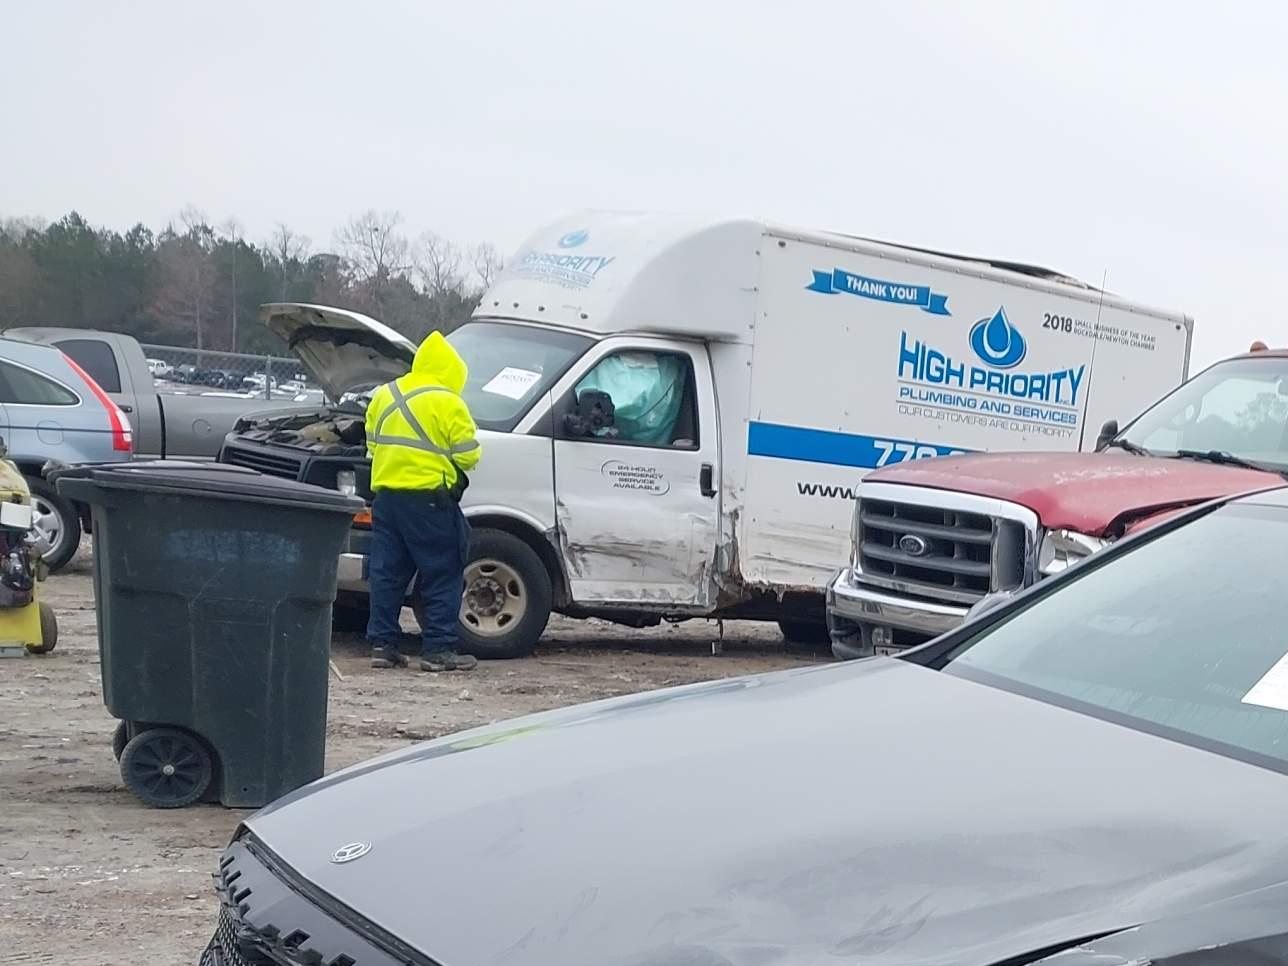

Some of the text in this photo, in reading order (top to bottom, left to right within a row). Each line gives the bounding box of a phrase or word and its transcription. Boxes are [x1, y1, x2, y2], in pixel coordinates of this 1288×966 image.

[846, 275, 918, 300] THANK YOU!
[1042, 312, 1073, 333] 2018
[1074, 319, 1092, 329] SMALL
[1120, 328, 1128, 337] OF
[898, 330, 1086, 407] HIGH PRIORITY
[899, 386, 1078, 425] PLUMBING AND SERVICES
[898, 406, 1074, 439] OUR CUSTOMERS ARE OUR PRIORITY
[608, 470, 664, 480] EMERGENCY
[618, 477, 655, 485] SERVICE
[613, 482, 661, 491] AVAILABLE
